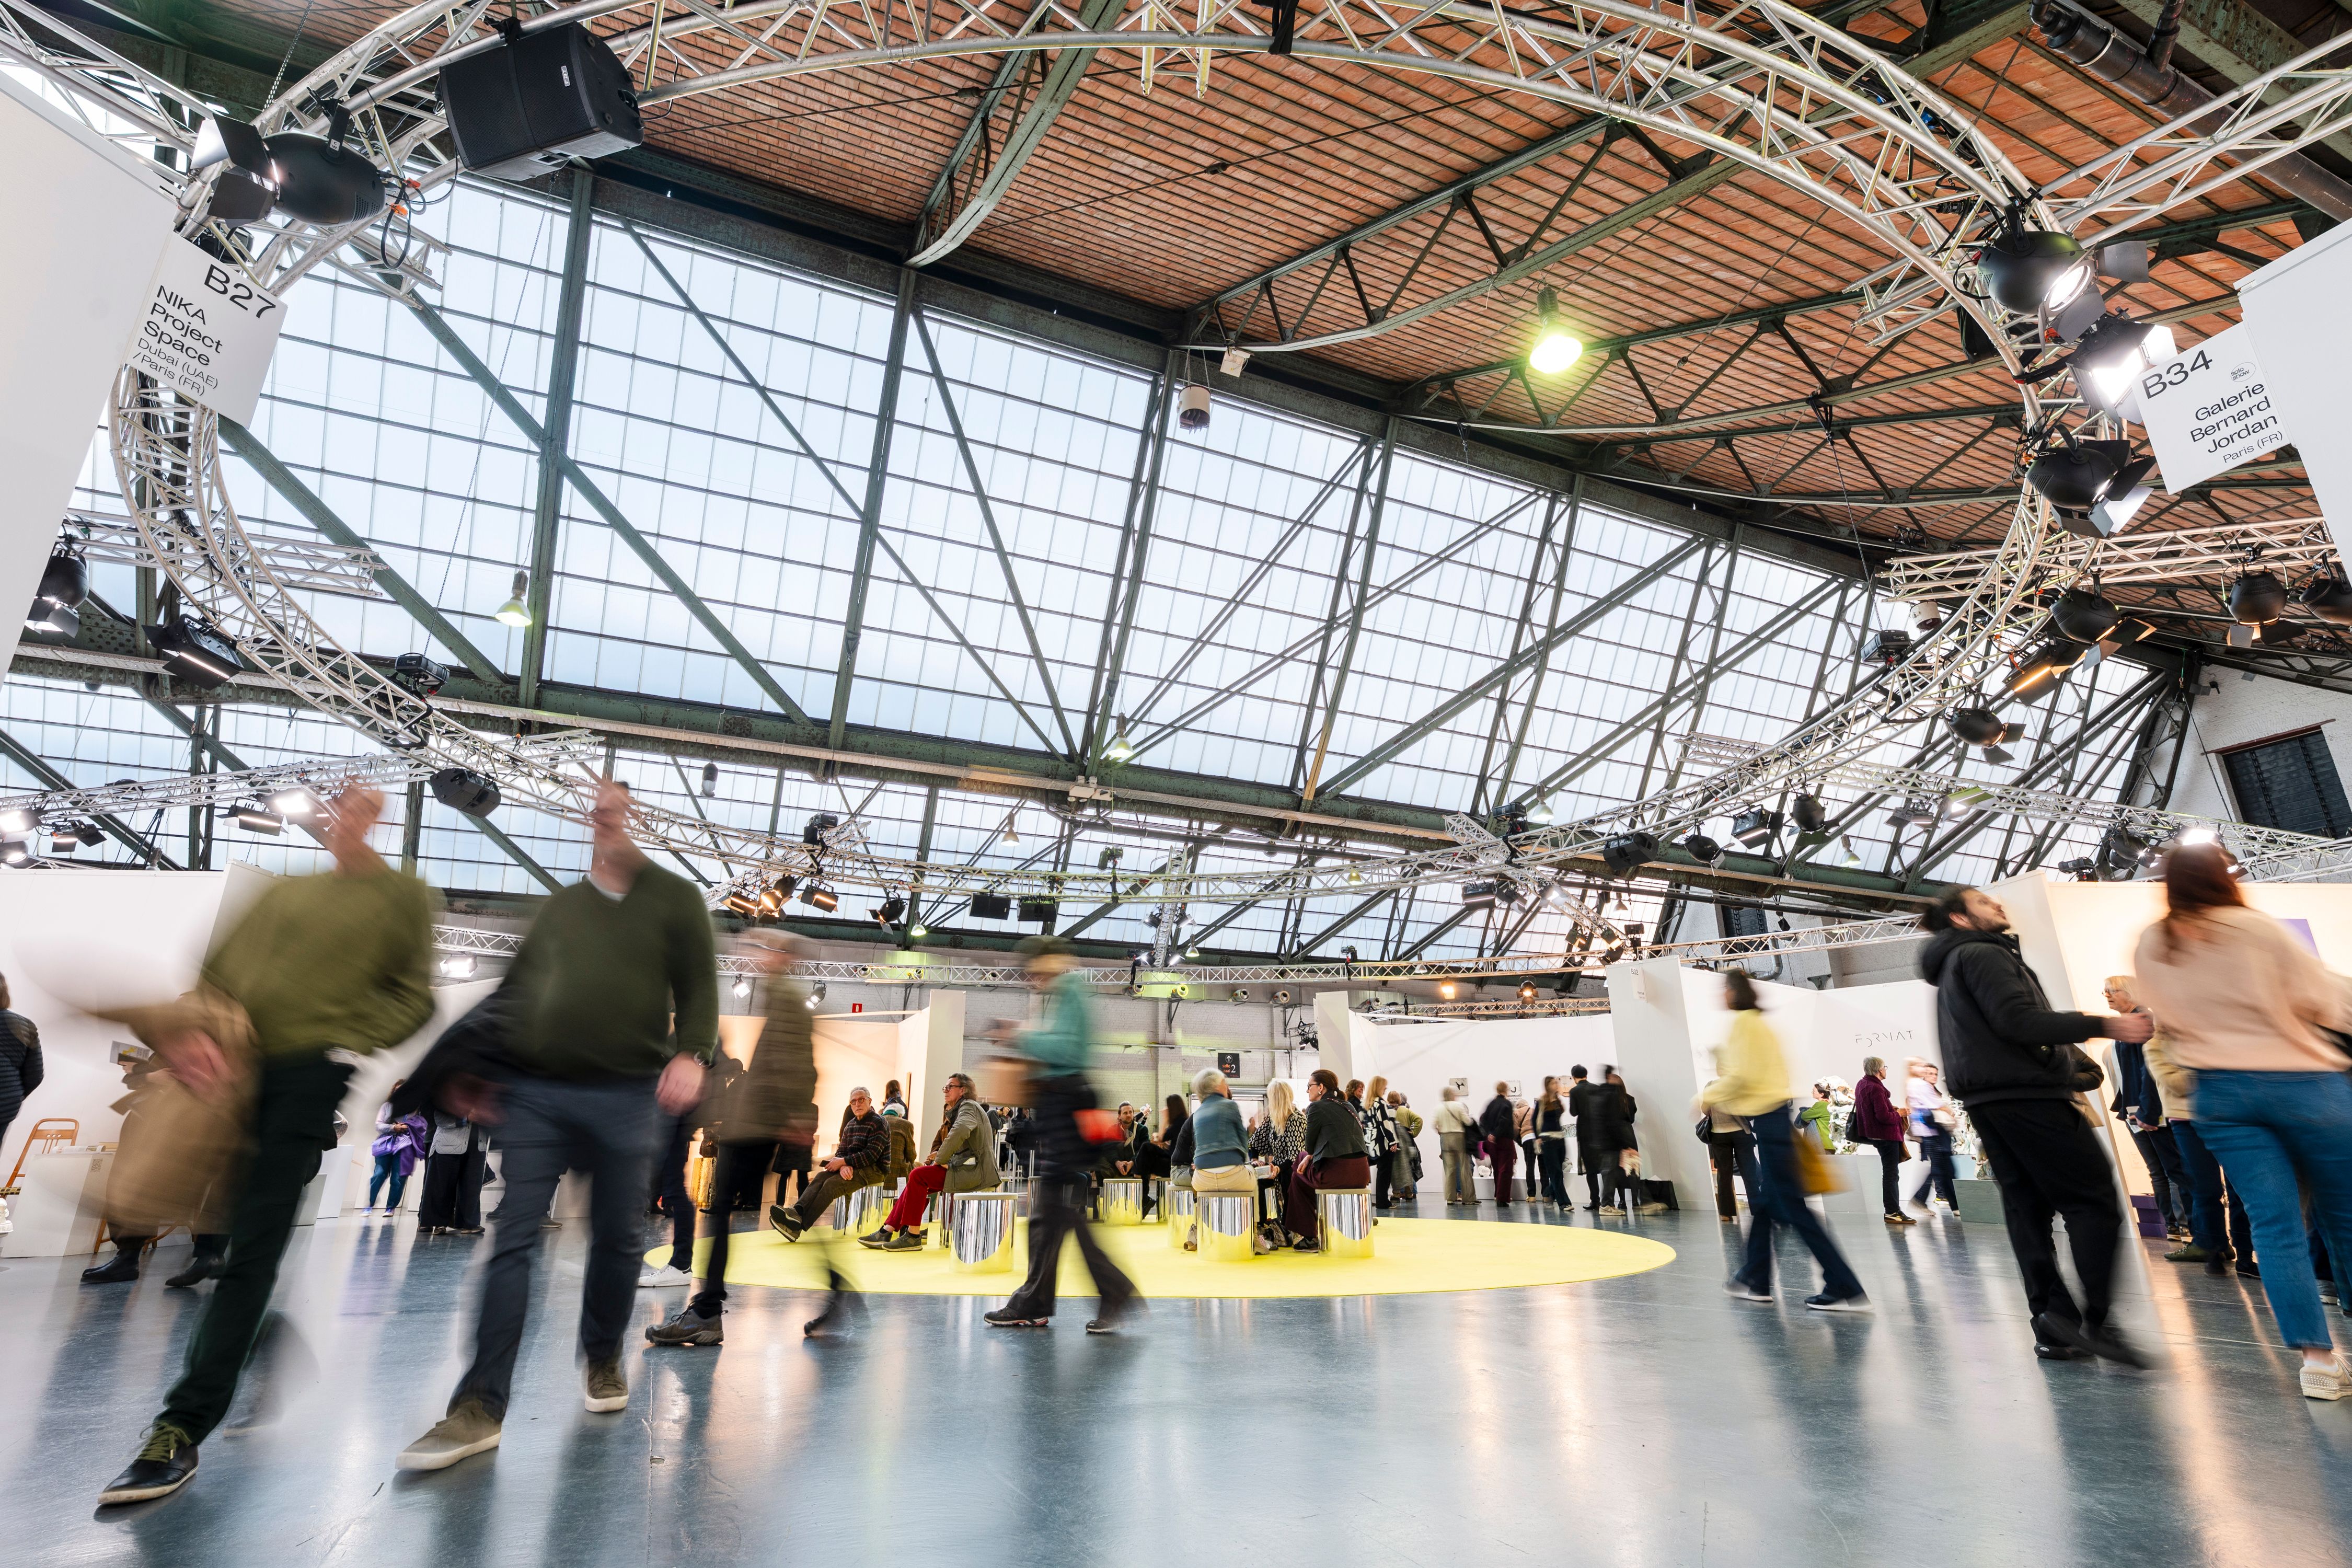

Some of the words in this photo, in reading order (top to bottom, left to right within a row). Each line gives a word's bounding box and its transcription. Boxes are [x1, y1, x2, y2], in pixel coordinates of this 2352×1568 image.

[156, 284, 206, 325] NIKA
[204, 263, 276, 319] B27
[144, 320, 210, 366] Space
[150, 302, 223, 354] Project
[137, 337, 179, 367] Dubai
[182, 361, 219, 389] (UAE)
[2141, 349, 2213, 400] B34
[2231, 367, 2244, 376] solo
[2232, 370, 2250, 380] show
[178, 374, 205, 396] (FR)
[2195, 383, 2265, 421] Galerie
[2190, 396, 2271, 443] Bernard
[2207, 415, 2278, 454] Jordan
[2223, 445, 2254, 464] Paris
[2257, 430, 2283, 450] (FR)
[1855, 1030, 1913, 1047] FORMAT
[1231, 1064, 1236, 1073] 2
